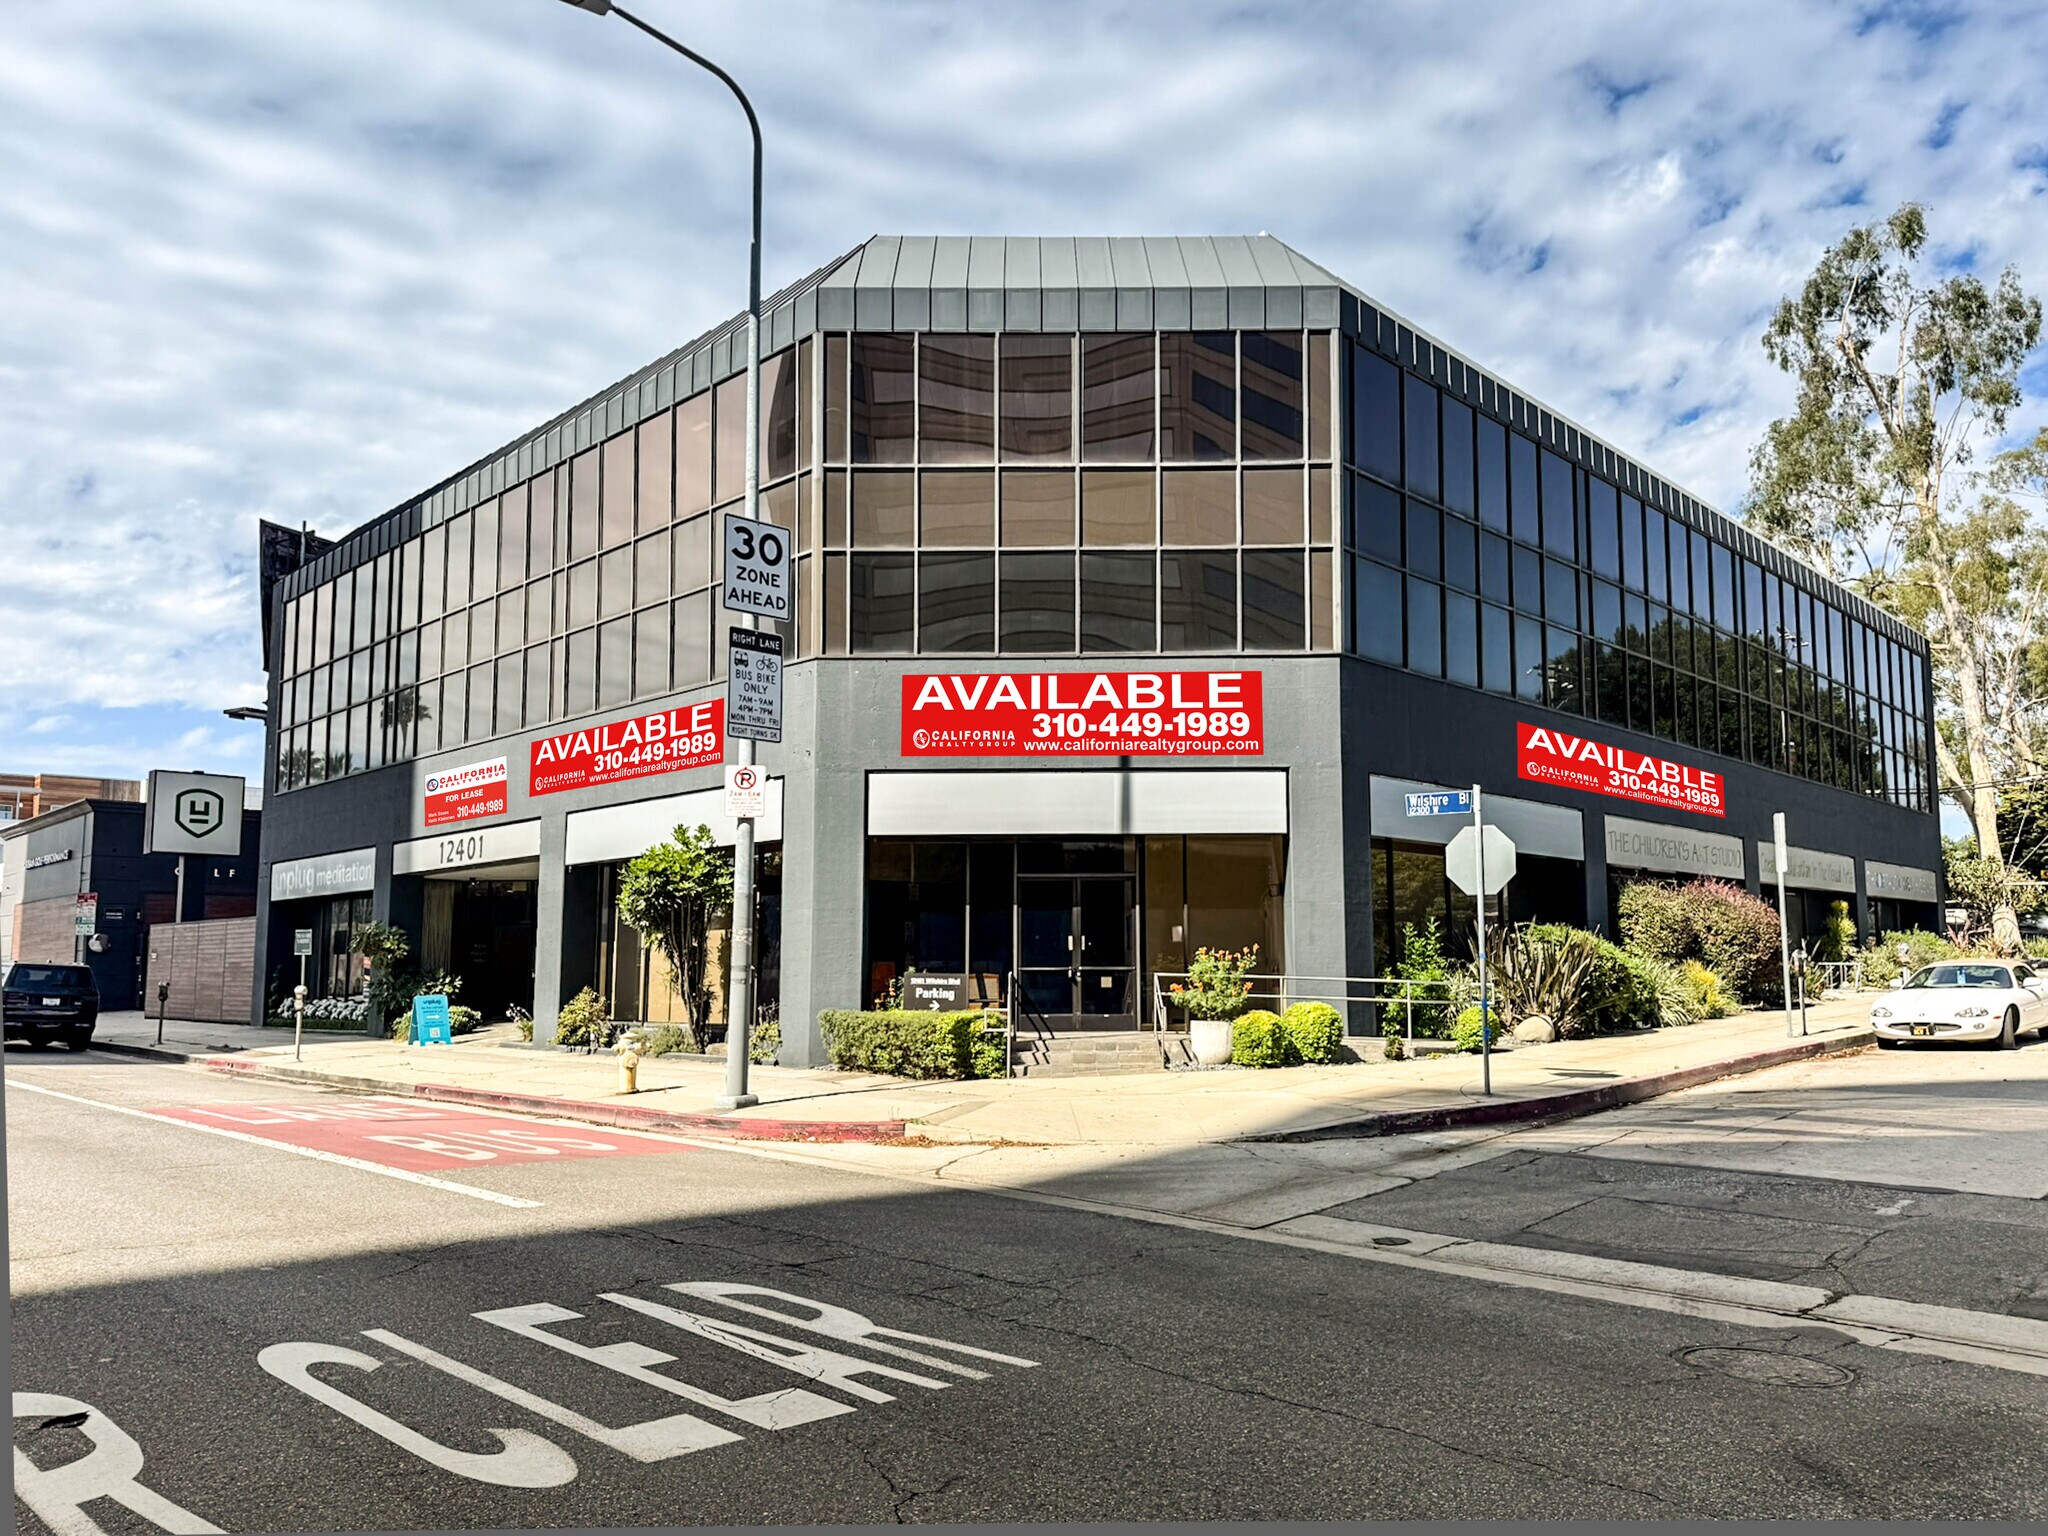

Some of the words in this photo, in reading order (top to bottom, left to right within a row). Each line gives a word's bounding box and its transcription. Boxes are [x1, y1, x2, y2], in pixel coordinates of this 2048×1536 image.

[731, 526, 783, 566] 30
[736, 565, 780, 588] ZONE
[728, 587, 786, 610] AHEAD
[732, 632, 755, 646] RIGHT
[759, 638, 780, 650] LANE
[735, 669, 752, 681] BUS
[757, 673, 776, 685] BIKE
[744, 682, 768, 695] ONLY
[912, 673, 1243, 710] AVAILABLE
[731, 712, 745, 721] MON
[749, 715, 766, 725] THRU
[769, 719, 779, 727] FRI
[1032, 712, 1250, 738] 310-449-1989
[535, 702, 713, 765] AVAILABLE
[731, 726, 748, 735] RIGHT
[750, 728, 768, 739] TURNS
[931, 730, 1015, 741] CALIFORNIA
[593, 731, 716, 772] 310-449-1989
[1023, 738, 1259, 753] www.californiarealtygroup.com
[589, 751, 721, 783] www.californiarealtygroup.com
[1526, 728, 1717, 792] AVAILABLE
[439, 778, 472, 789] REALTY
[475, 770, 506, 781] GROUP
[440, 763, 506, 785] CALIFORNIA
[544, 769, 586, 783] CALIFORNIA
[1541, 765, 1599, 783] CALIFORNIA
[445, 793, 459, 803] FOR
[460, 788, 484, 800] LEASE
[1409, 794, 1449, 807] Wilshire
[1459, 792, 1469, 804] Bl
[1603, 785, 1724, 815] www.californiarealtygroup.com
[1608, 770, 1719, 807] 310-449-1989
[456, 798, 504, 818] 310-449-1989
[1409, 806, 1430, 815] 12300
[1432, 805, 1439, 814] W
[440, 835, 483, 864] 12401
[1608, 830, 1630, 852] THE
[1632, 833, 1690, 860] CHILDREN'S
[1710, 846, 1742, 868] STUDIO
[274, 863, 315, 896] unplug
[316, 861, 372, 887] meditation
[915, 987, 955, 1001] Parking
[189, 1102, 448, 1125] LANE
[360, 1129, 618, 1161] BUS
[257, 1281, 1042, 1488] CLEAR
